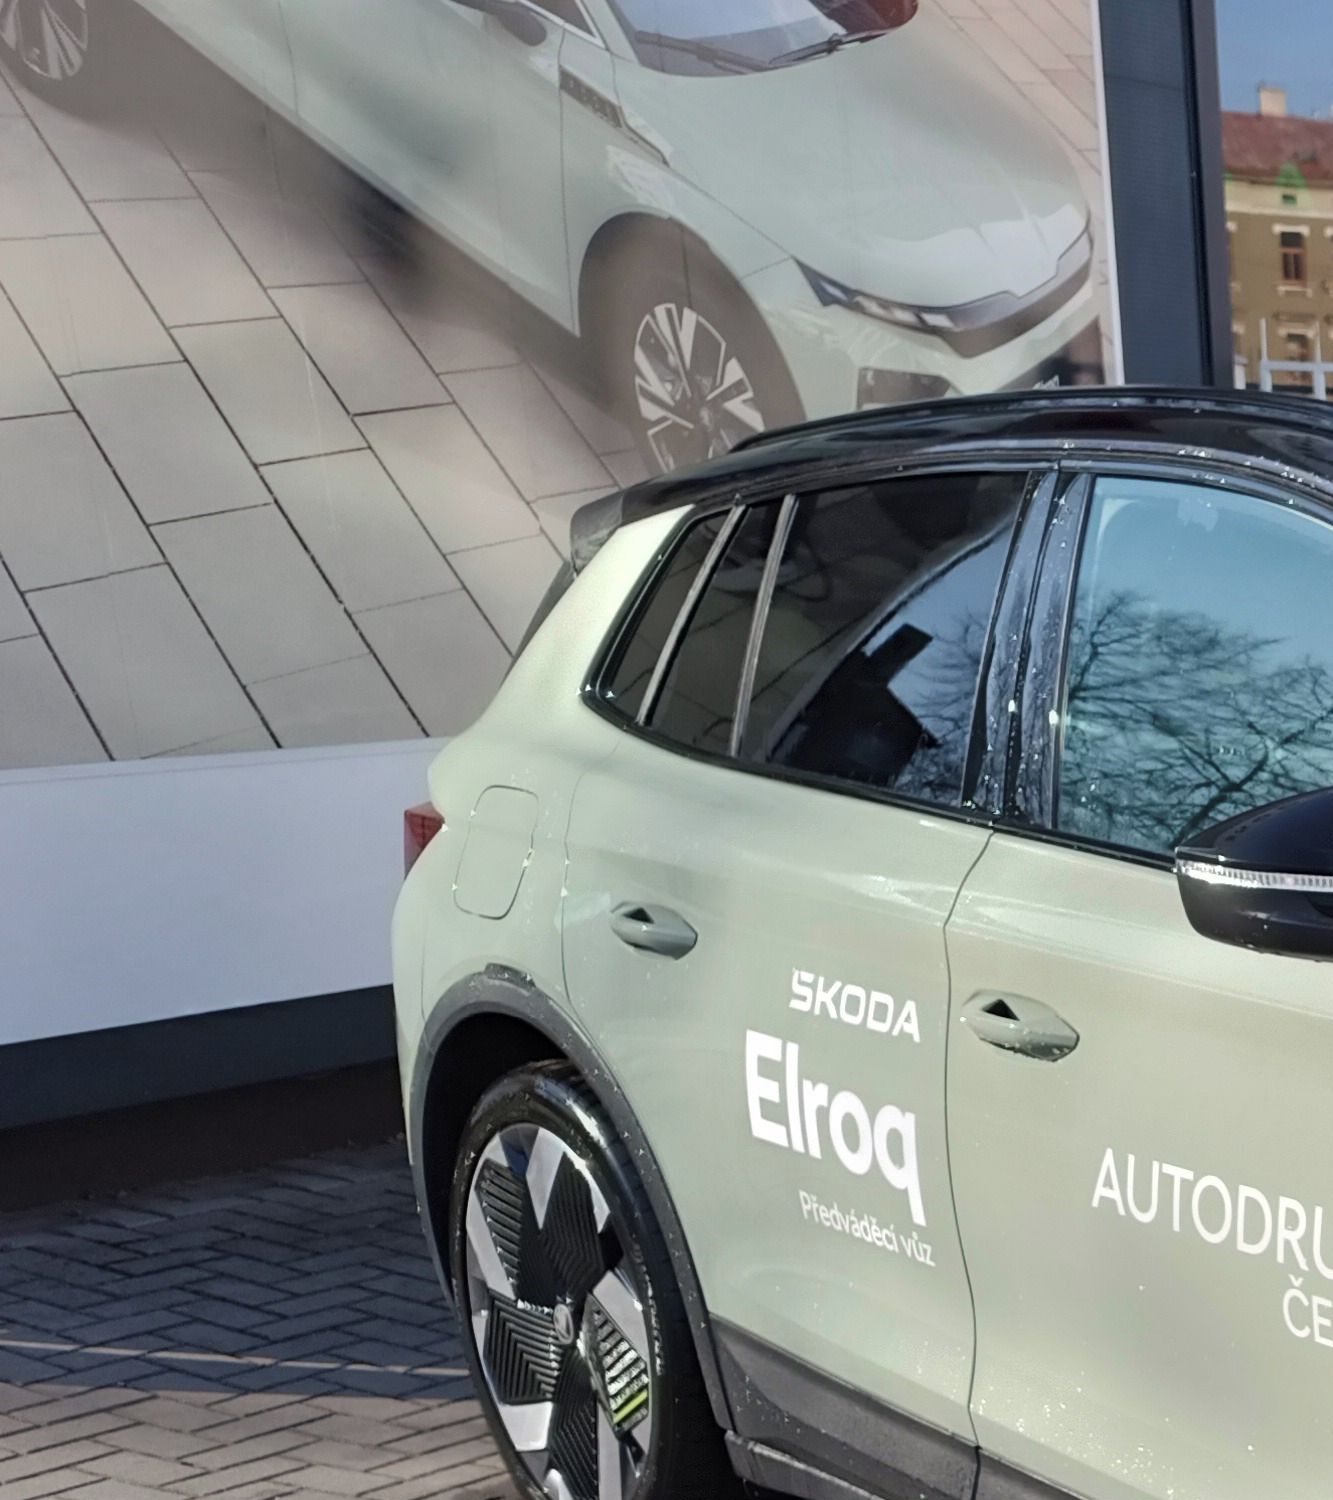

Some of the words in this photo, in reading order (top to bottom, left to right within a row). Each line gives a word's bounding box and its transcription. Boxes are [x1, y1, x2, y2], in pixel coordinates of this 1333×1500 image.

[745, 1029, 926, 1227] Elroq
[799, 1189, 900, 1253] Předváděcí
[900, 1231, 936, 1267] vůz
